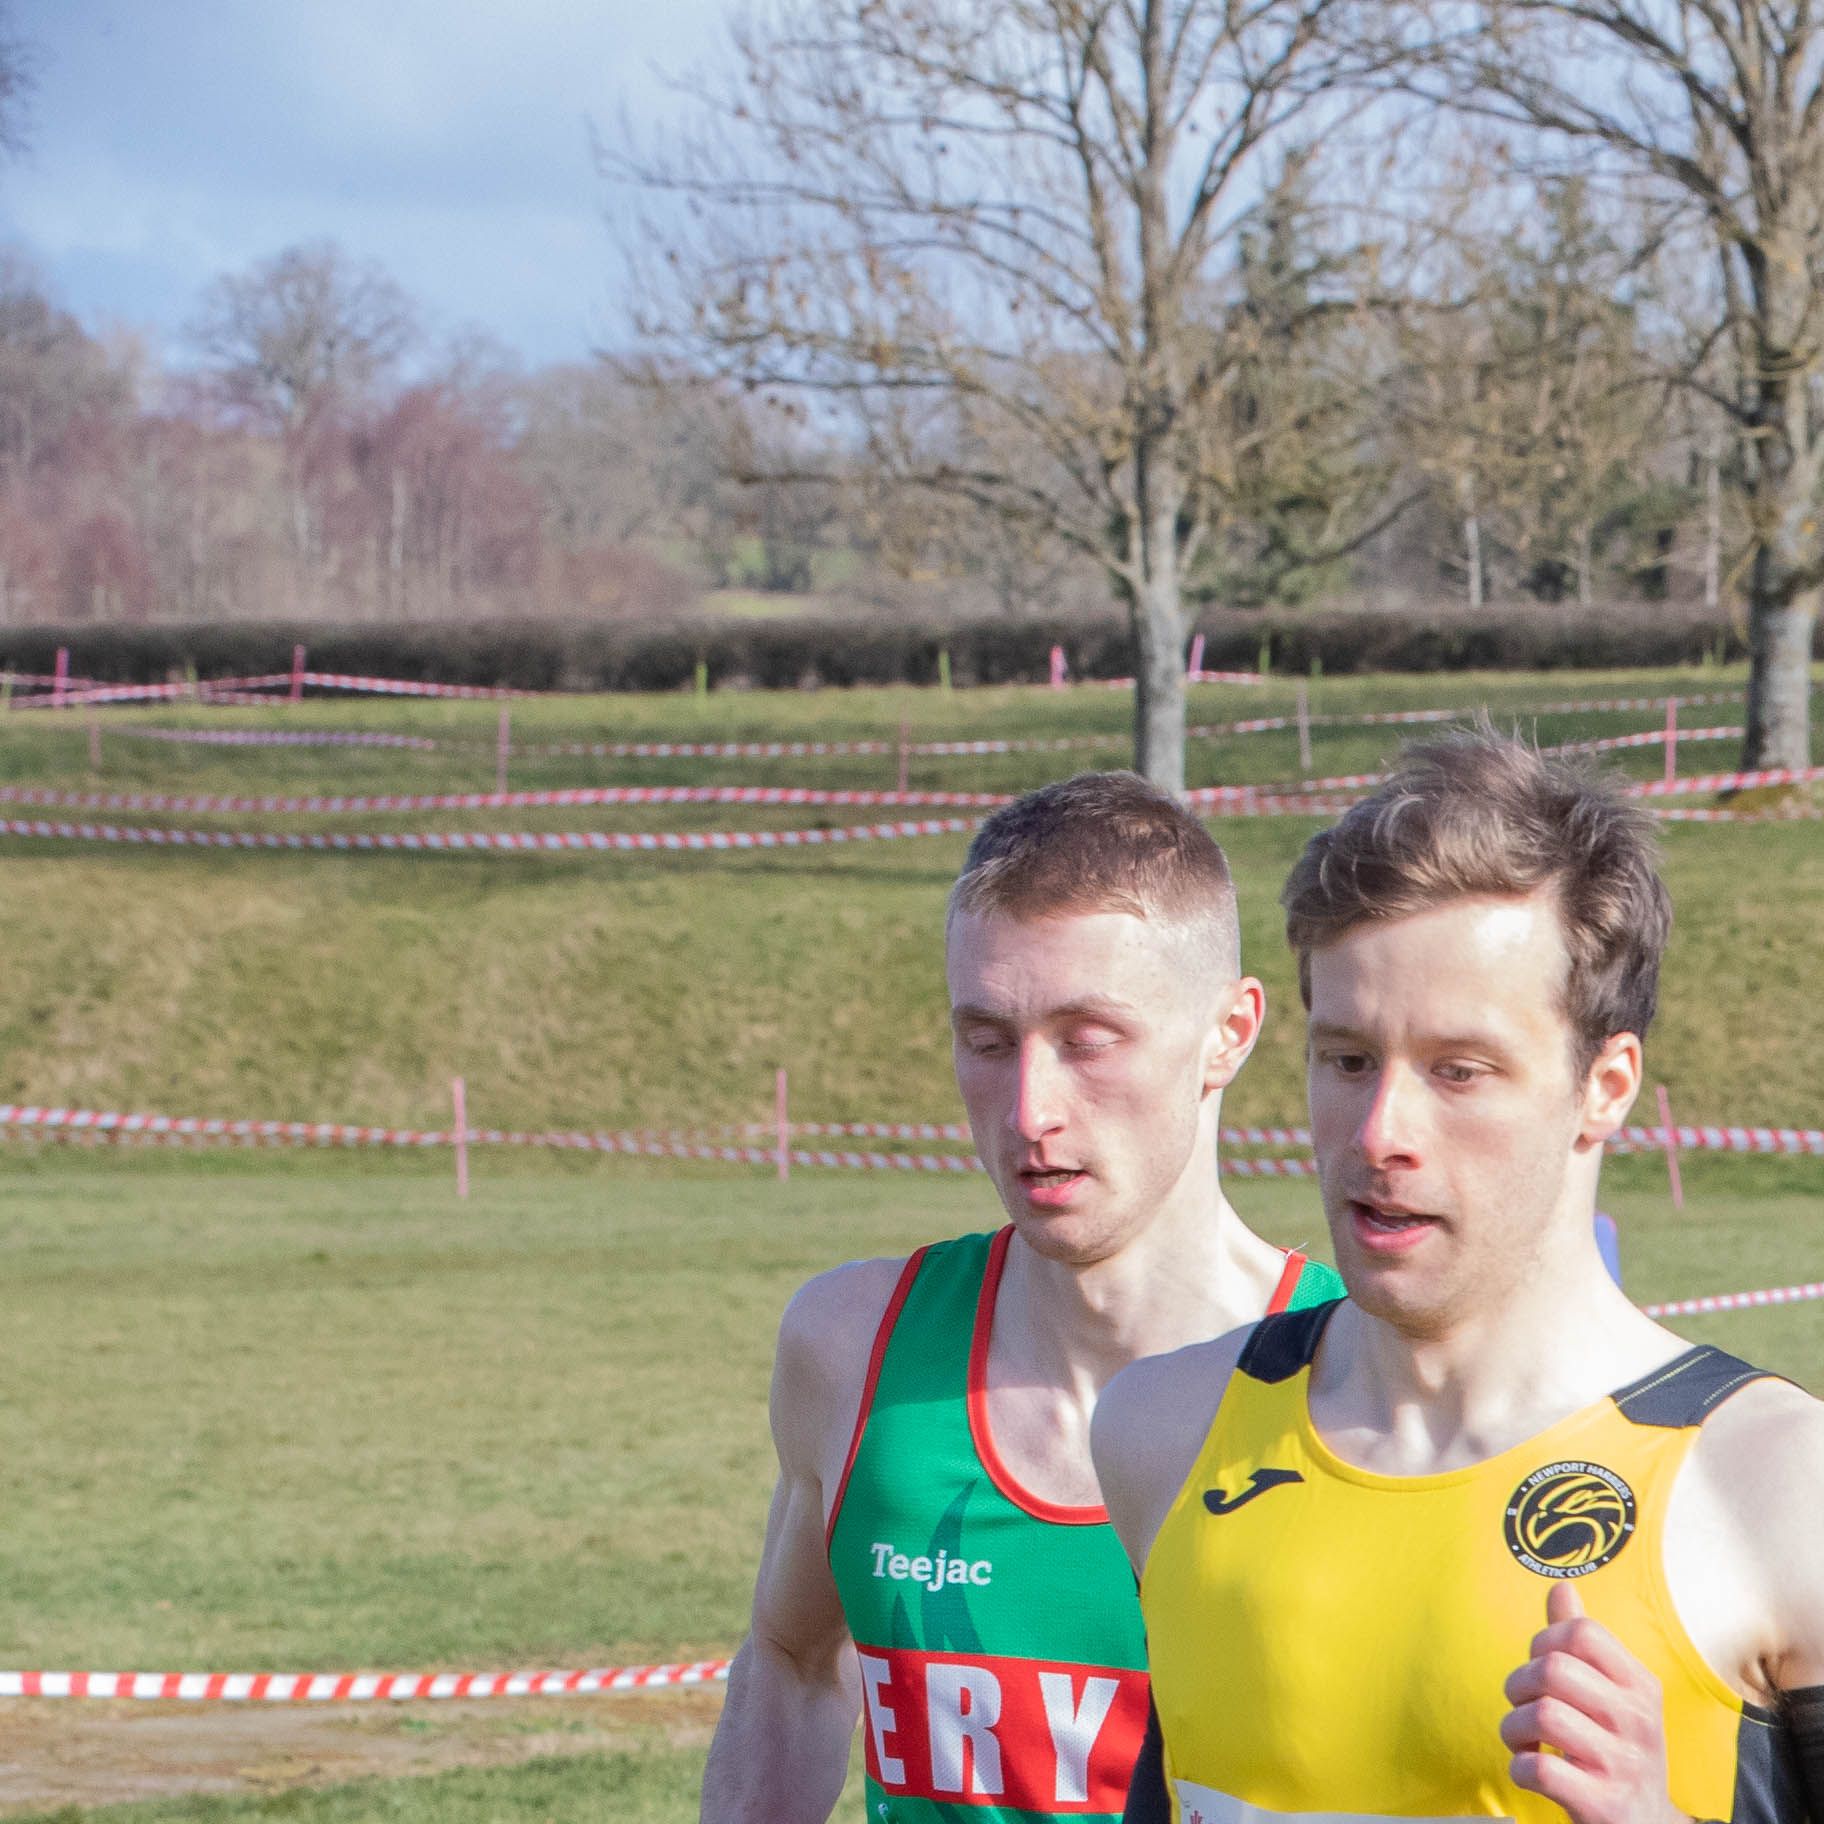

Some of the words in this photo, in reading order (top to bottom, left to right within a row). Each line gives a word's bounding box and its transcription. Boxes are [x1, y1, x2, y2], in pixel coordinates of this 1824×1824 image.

[1527, 1462, 1587, 1487] NEWPORT
[870, 1542, 993, 1592] Teejac
[858, 1653, 1121, 1803] ERY
